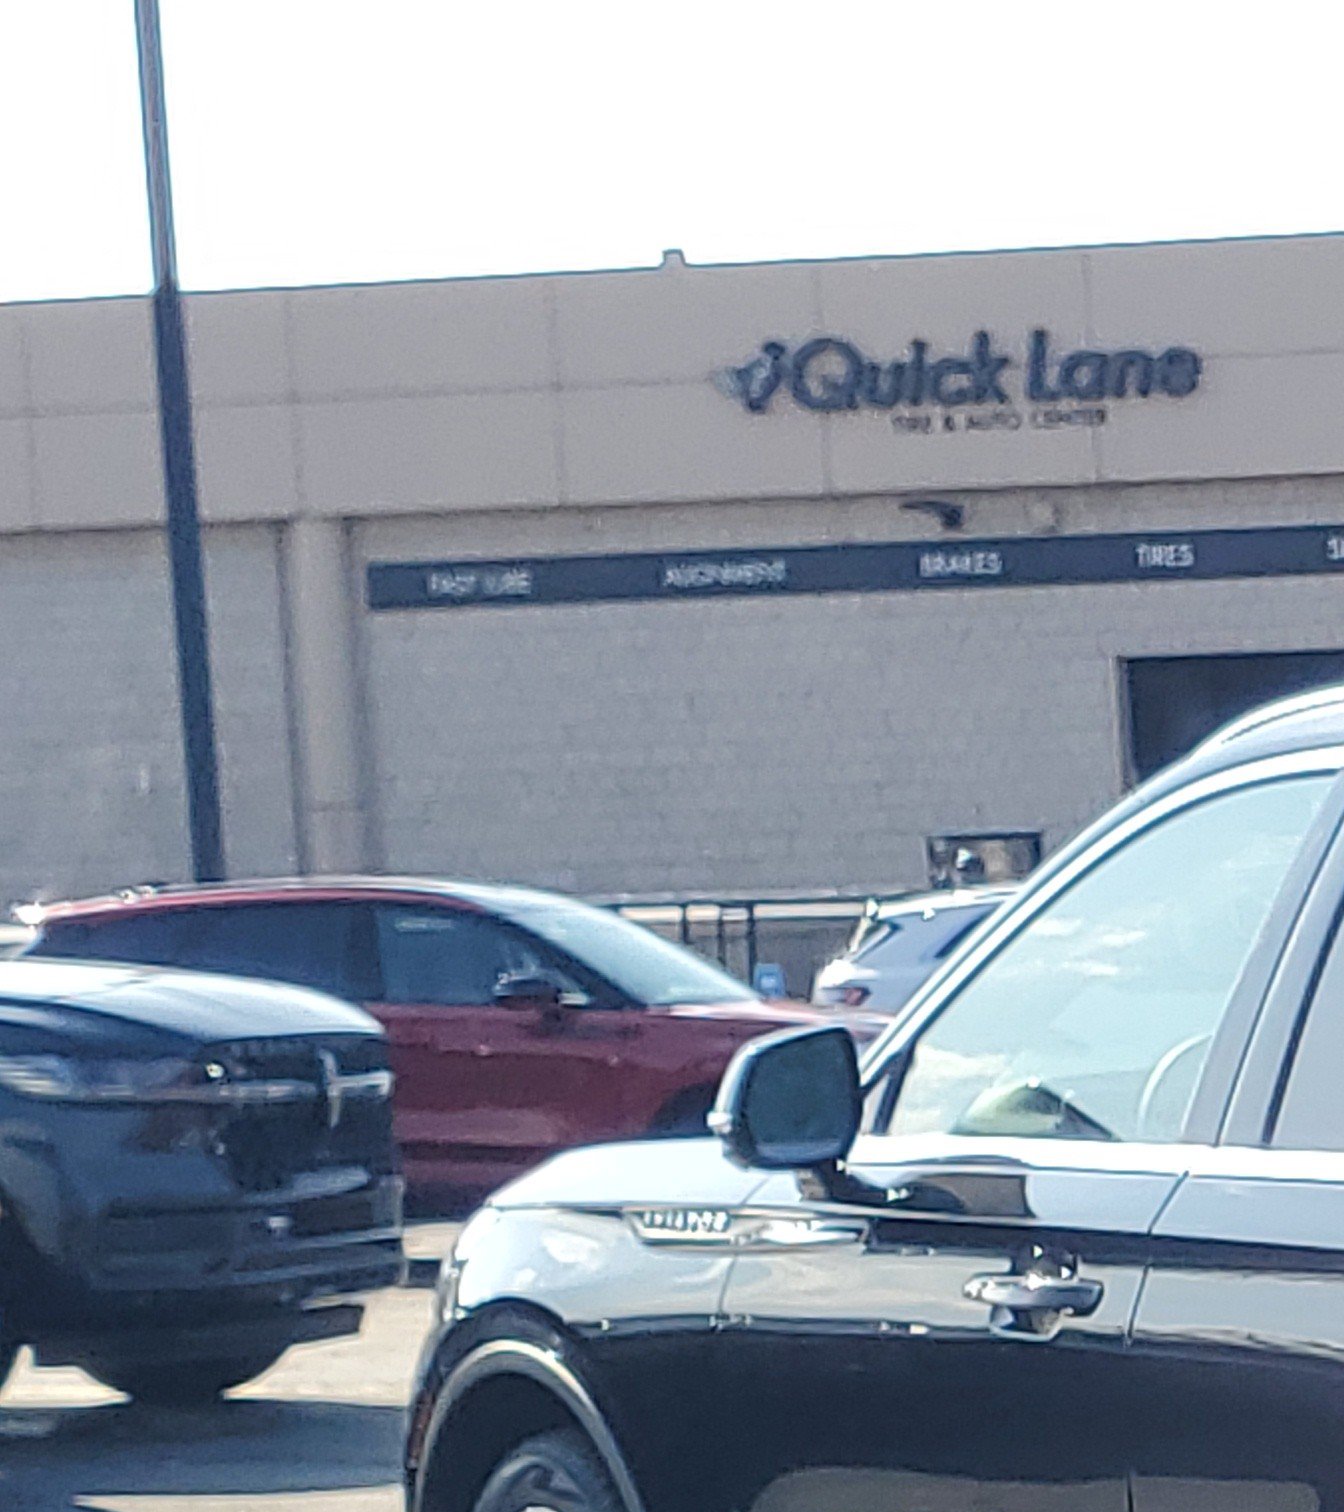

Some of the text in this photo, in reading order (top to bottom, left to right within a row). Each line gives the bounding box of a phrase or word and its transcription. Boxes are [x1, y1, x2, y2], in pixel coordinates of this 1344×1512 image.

[793, 330, 1203, 411] Quick Lane
[1136, 542, 1194, 568] TIRES
